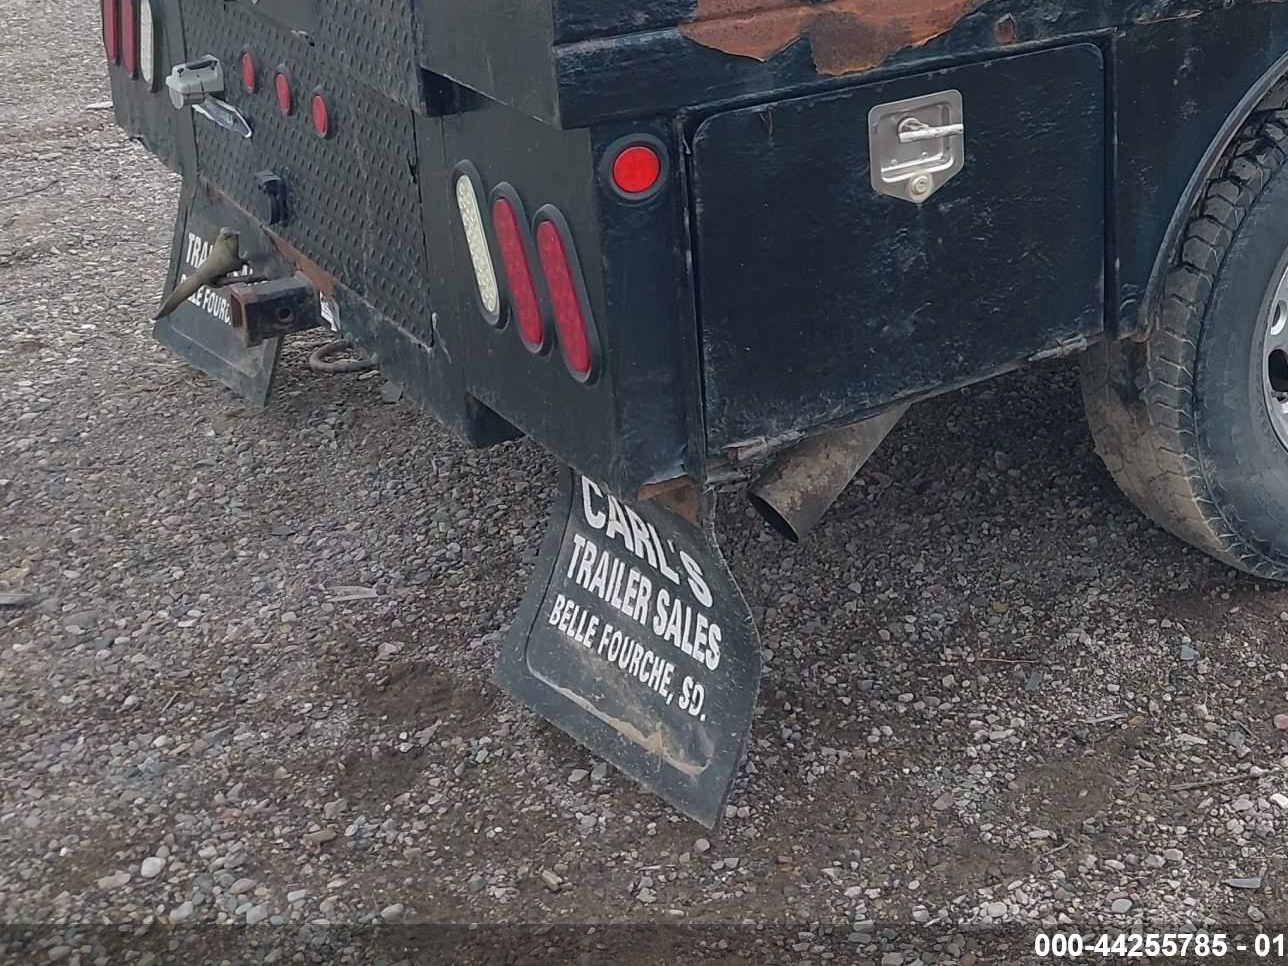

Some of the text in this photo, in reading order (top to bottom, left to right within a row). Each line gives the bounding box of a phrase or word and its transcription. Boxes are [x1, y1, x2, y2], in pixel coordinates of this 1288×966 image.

[565, 533, 722, 671] TRAILER SALES
[581, 474, 714, 608] CARL'S
[548, 594, 708, 722] BELLE FOURCHE, SD.
